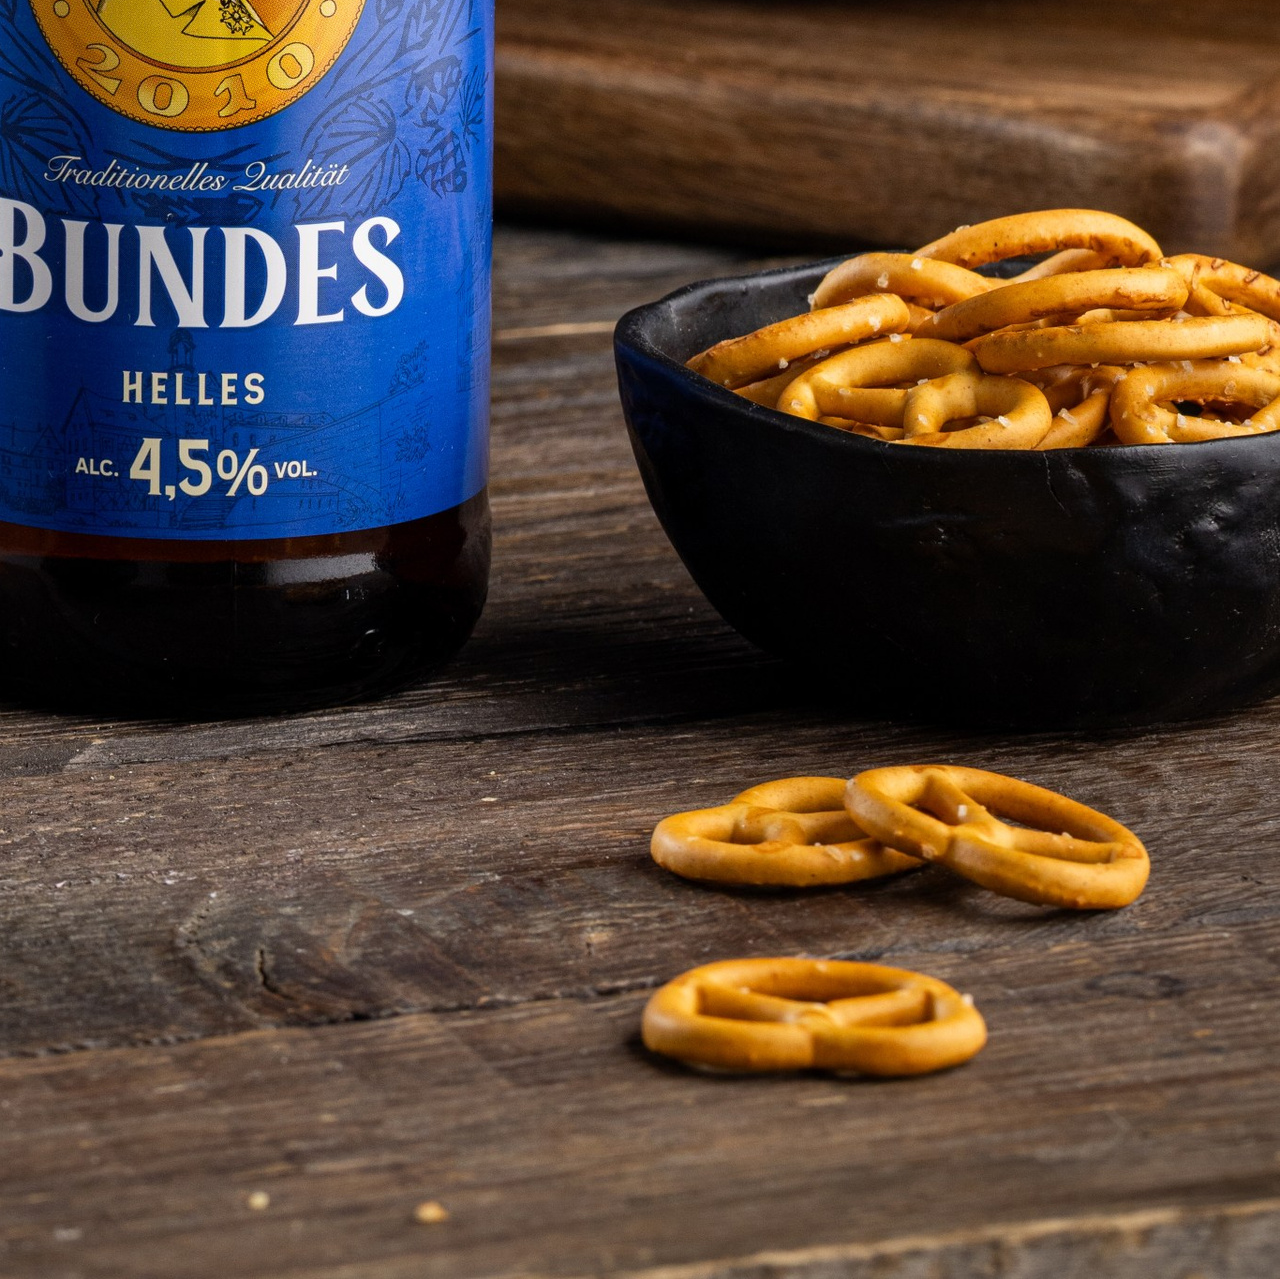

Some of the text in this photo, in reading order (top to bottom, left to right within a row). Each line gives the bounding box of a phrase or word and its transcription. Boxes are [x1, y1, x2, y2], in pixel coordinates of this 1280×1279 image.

[75, 41, 315, 119] 2010
[43, 155, 350, 191] Traditionelles Qualität
[122, 370, 265, 406] HELLES
[75, 437, 318, 502] ALC. 4,5% VOL.
